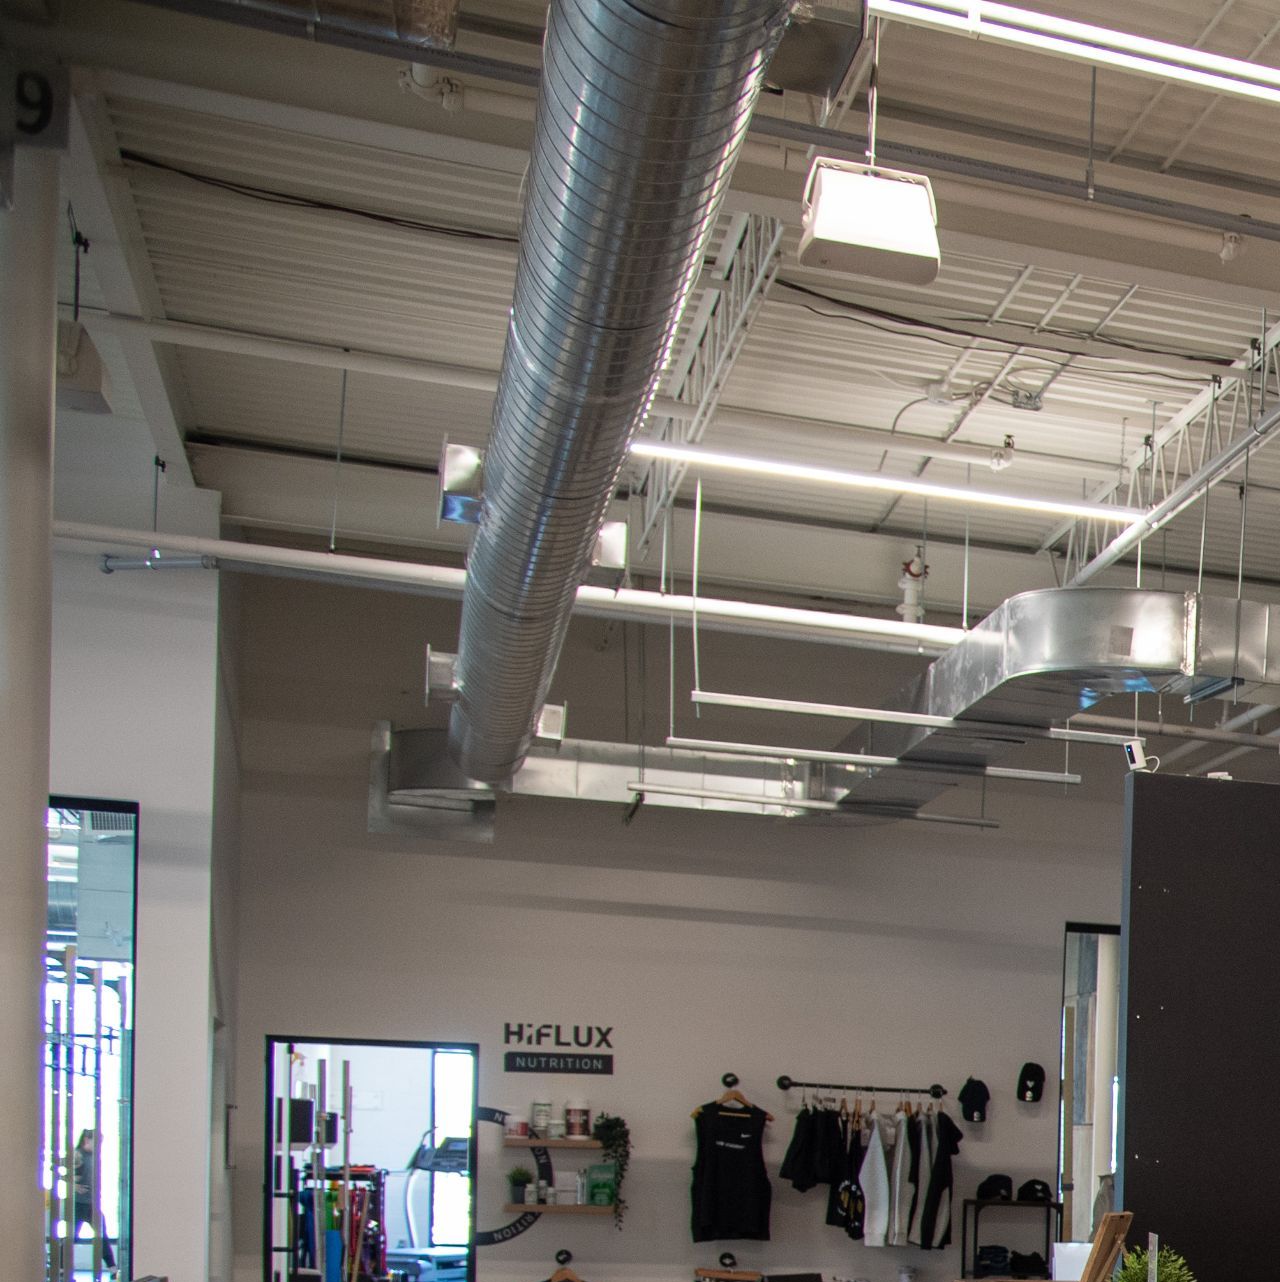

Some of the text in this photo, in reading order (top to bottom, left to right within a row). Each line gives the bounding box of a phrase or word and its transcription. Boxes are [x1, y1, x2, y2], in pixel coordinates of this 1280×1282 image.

[15, 70, 54, 136] 9
[503, 1022, 613, 1048] HiFLUX
[515, 1055, 603, 1070] NUTRITION
